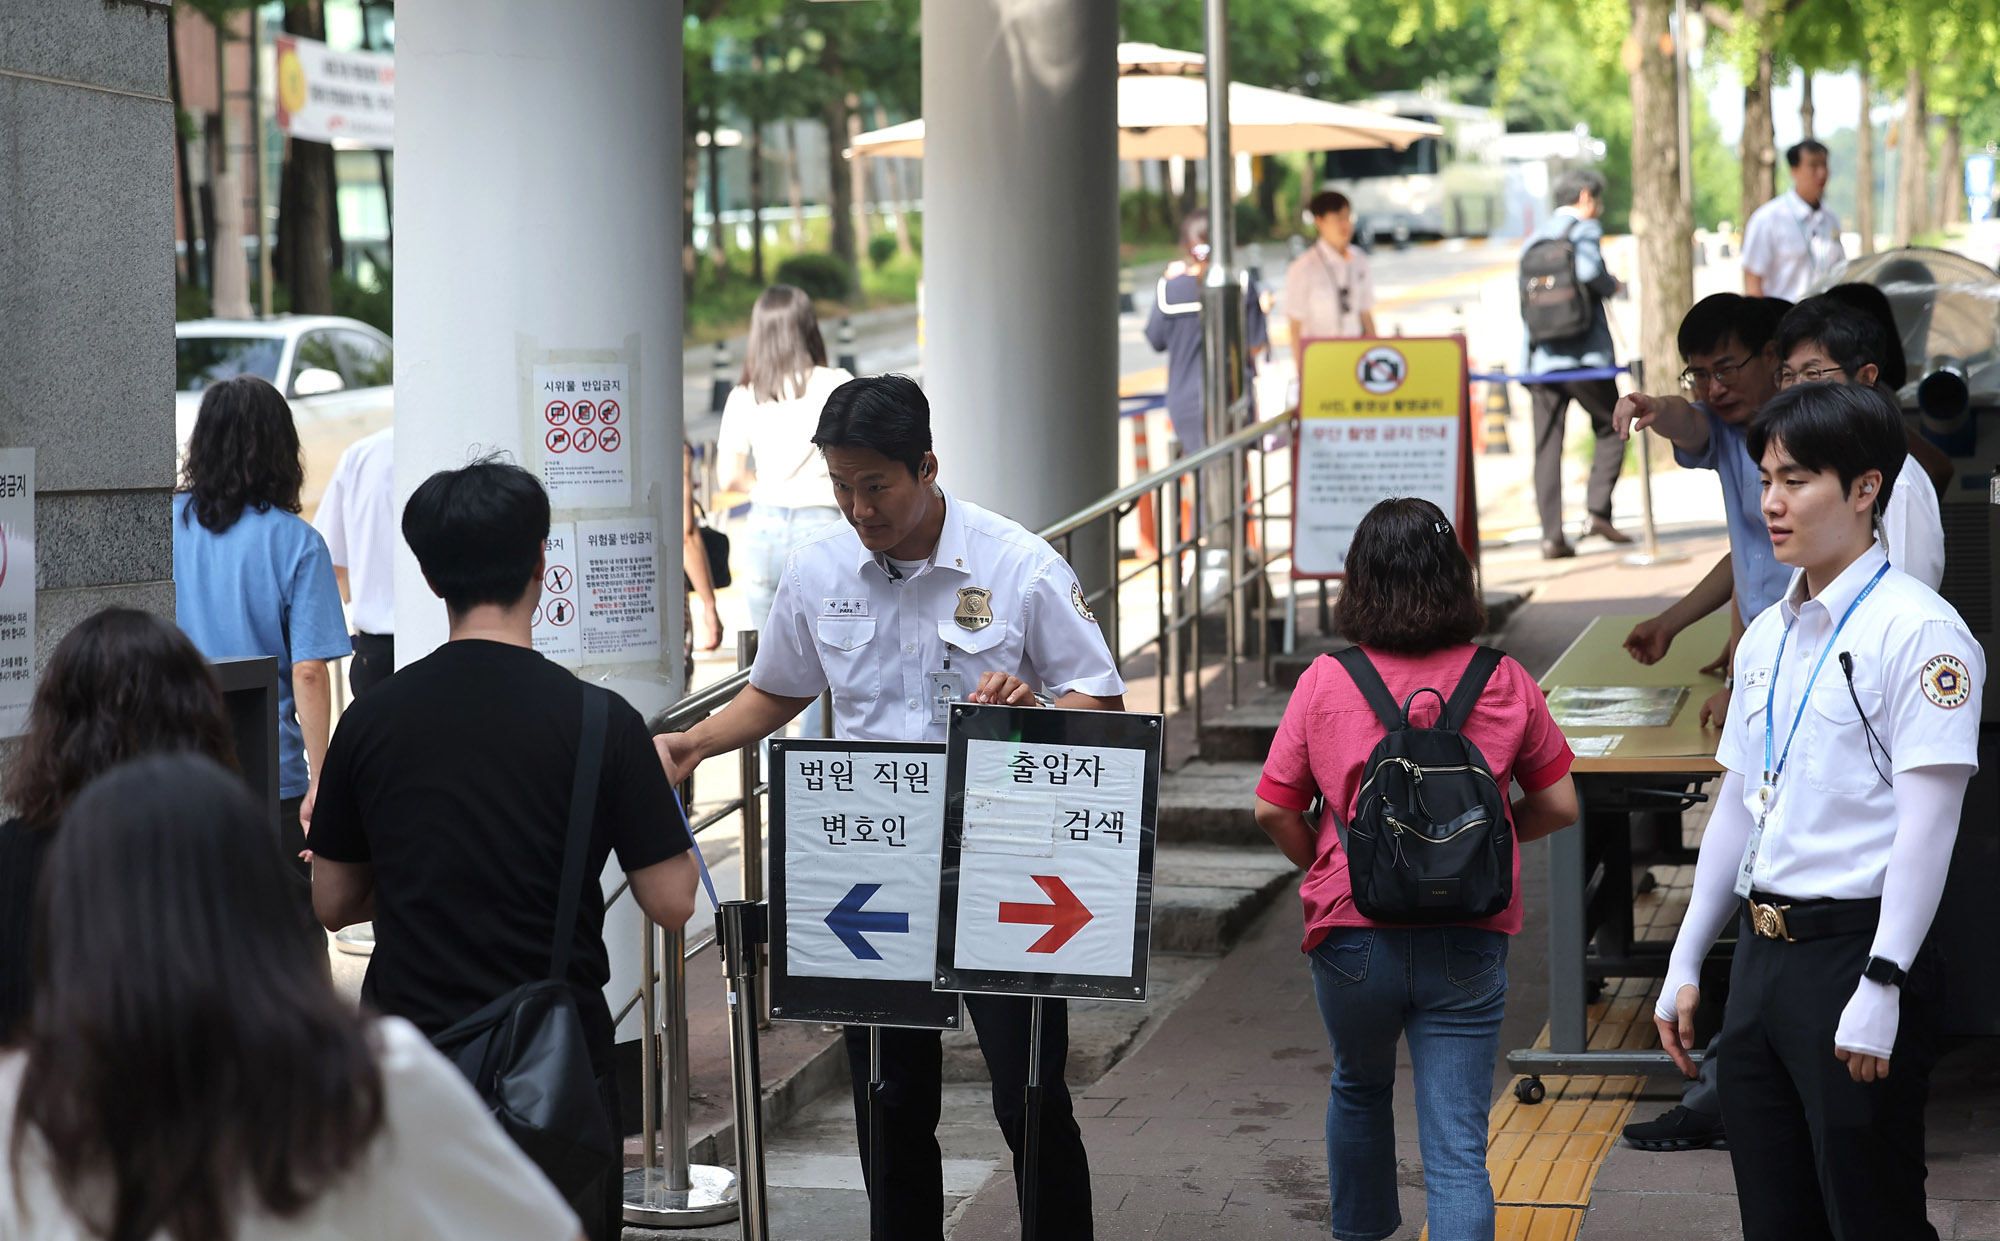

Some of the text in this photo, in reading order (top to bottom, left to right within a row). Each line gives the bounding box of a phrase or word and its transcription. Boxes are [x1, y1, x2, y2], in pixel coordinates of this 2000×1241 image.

[544, 380, 620, 392] 시위물 반입금지
[1313, 425, 1448, 442] 무단 촬영 금지 안내
[588, 531, 652, 547] 위험물 반입금지
[799, 759, 930, 794] 법원 직원
[1008, 750, 1106, 787] 출입자
[821, 814, 907, 848] 변호인
[1064, 808, 1125, 844] 검색
